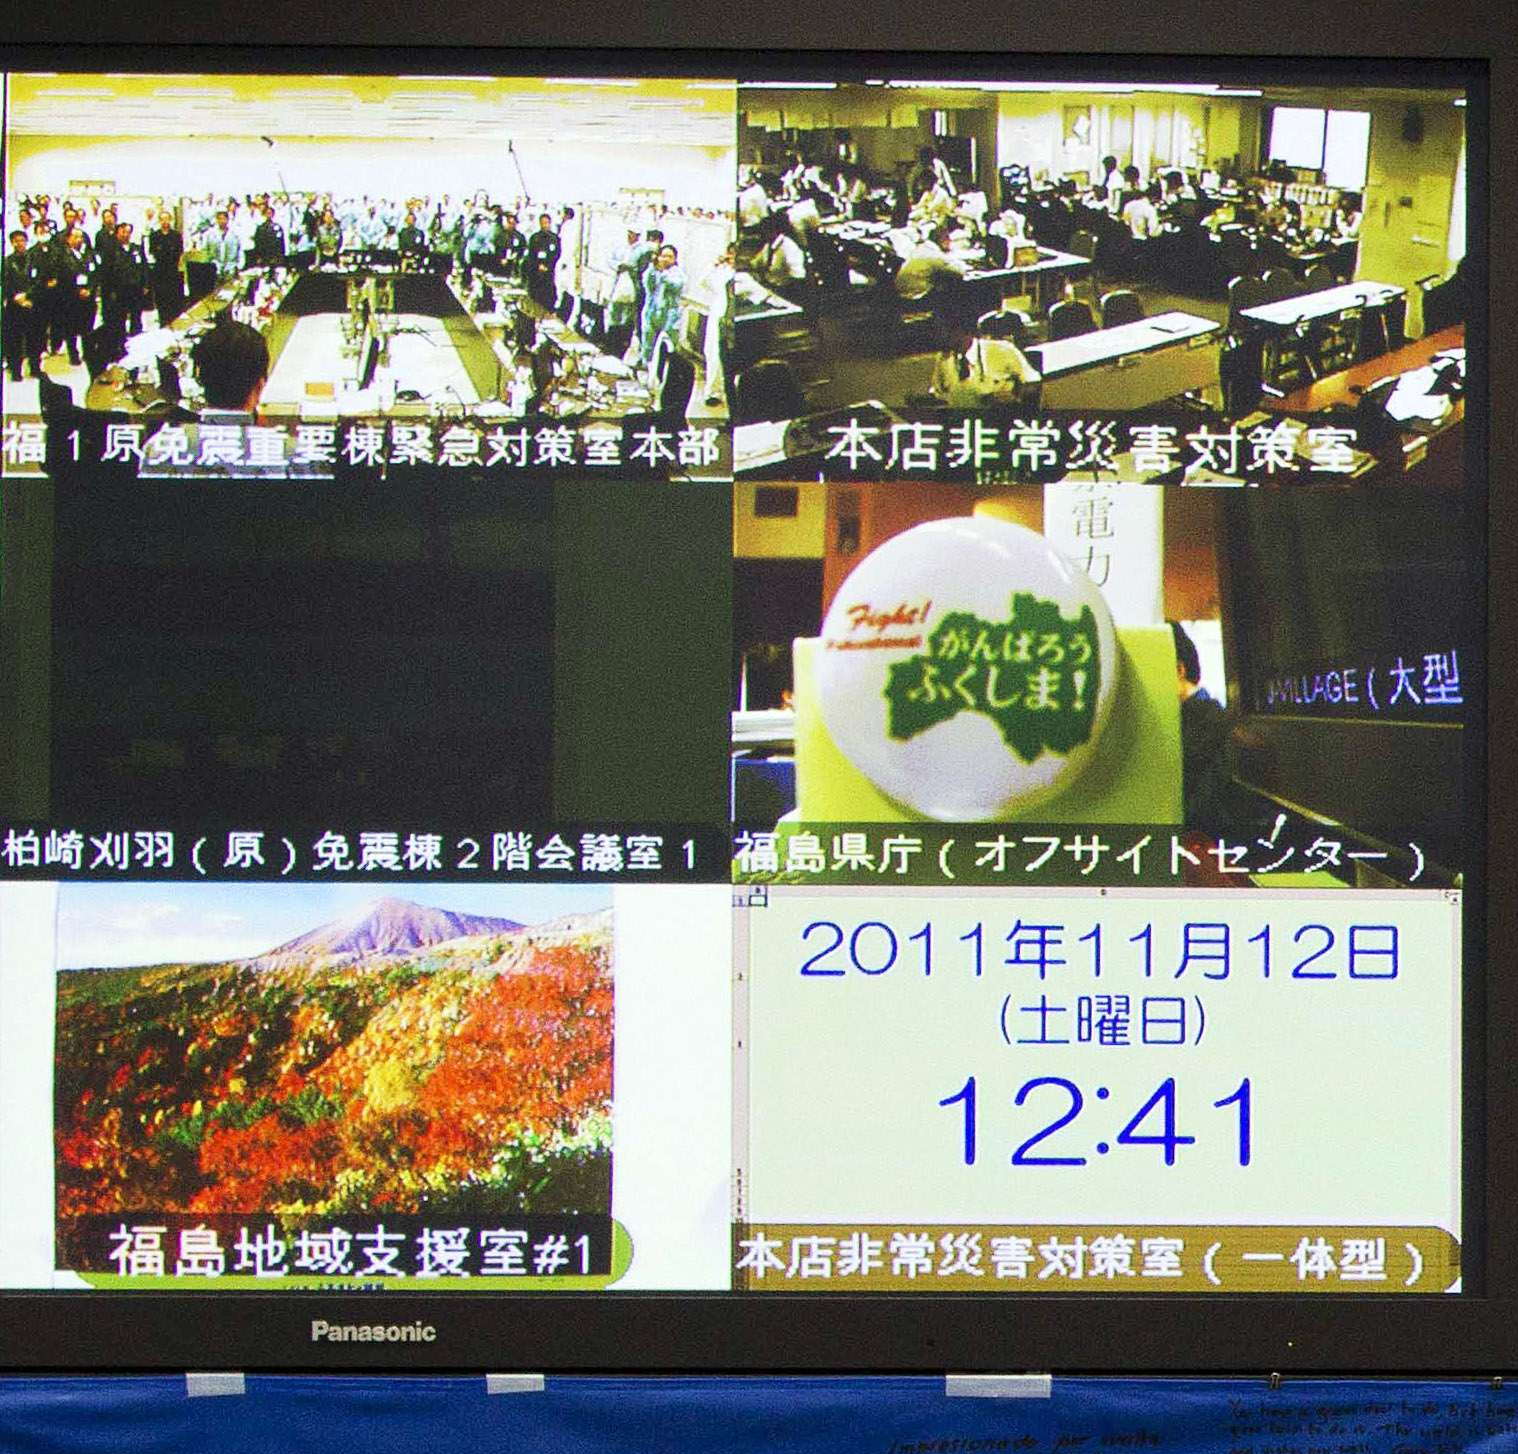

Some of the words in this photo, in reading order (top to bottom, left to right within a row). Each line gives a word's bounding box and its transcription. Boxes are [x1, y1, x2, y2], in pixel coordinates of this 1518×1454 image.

[827, 418, 1360, 474] 本店非常災害対策室
[938, 627, 1095, 668] がんばろう
[939, 1076, 1253, 1167] 12:41
[311, 1320, 437, 1342] Panasonic
